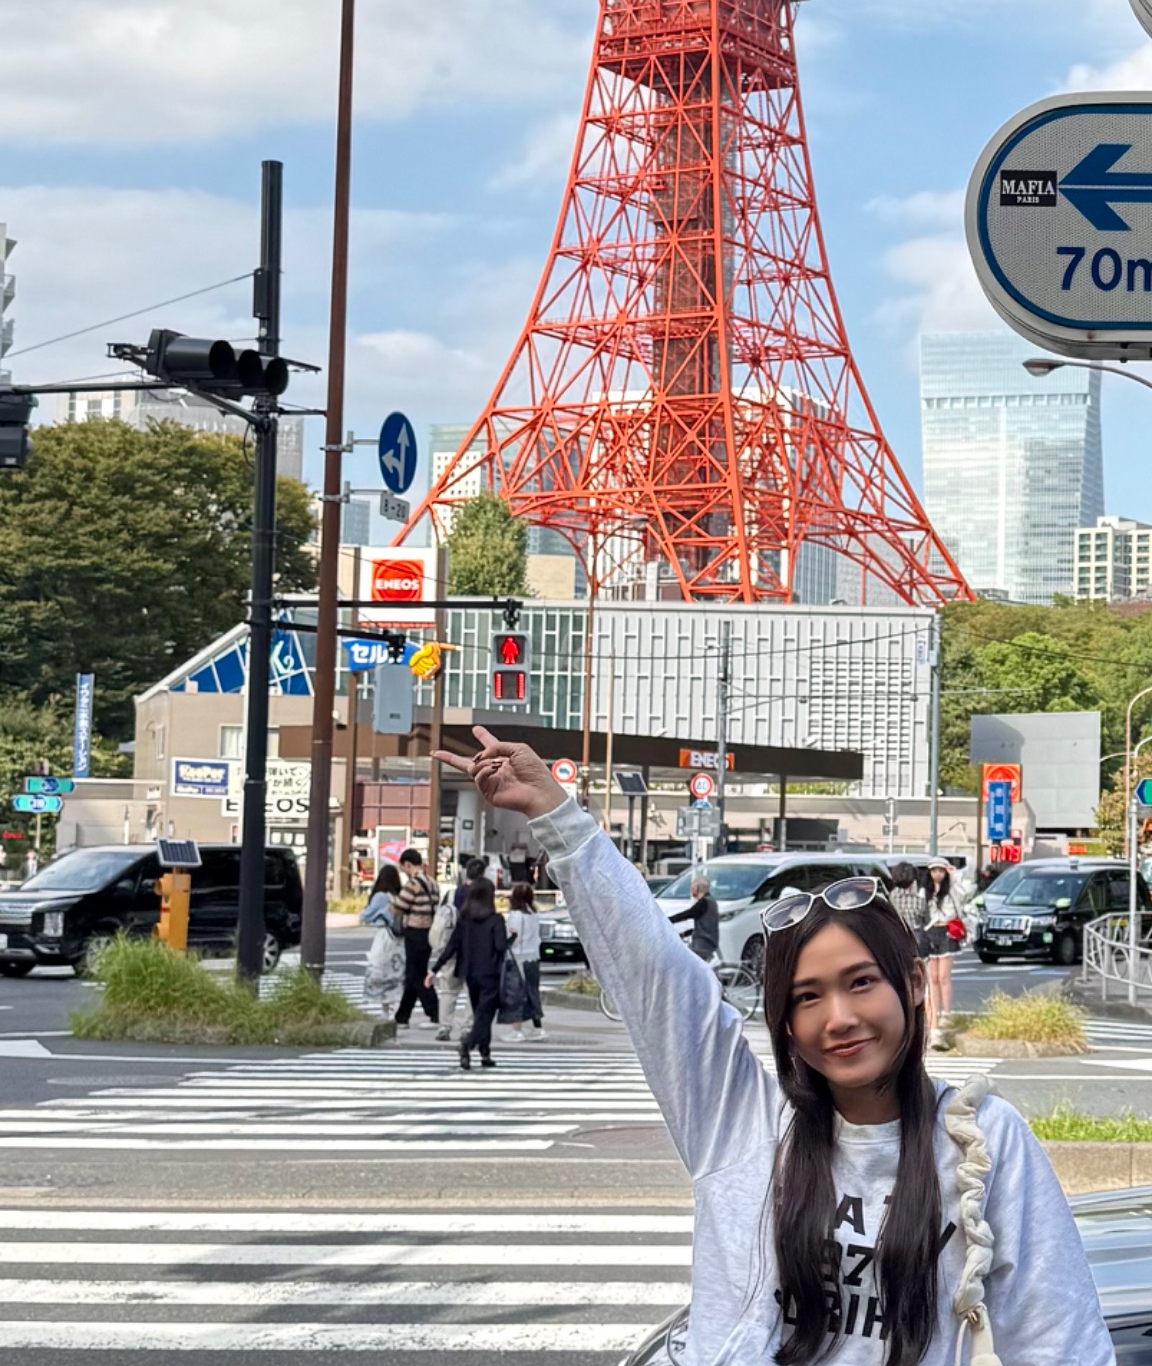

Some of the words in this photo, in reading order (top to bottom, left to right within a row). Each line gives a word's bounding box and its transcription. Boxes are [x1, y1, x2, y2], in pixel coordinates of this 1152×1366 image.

[1001, 179, 1055, 195] MAFIA
[1016, 196, 1040, 204] PARIS
[375, 578, 420, 591] ENEOS
